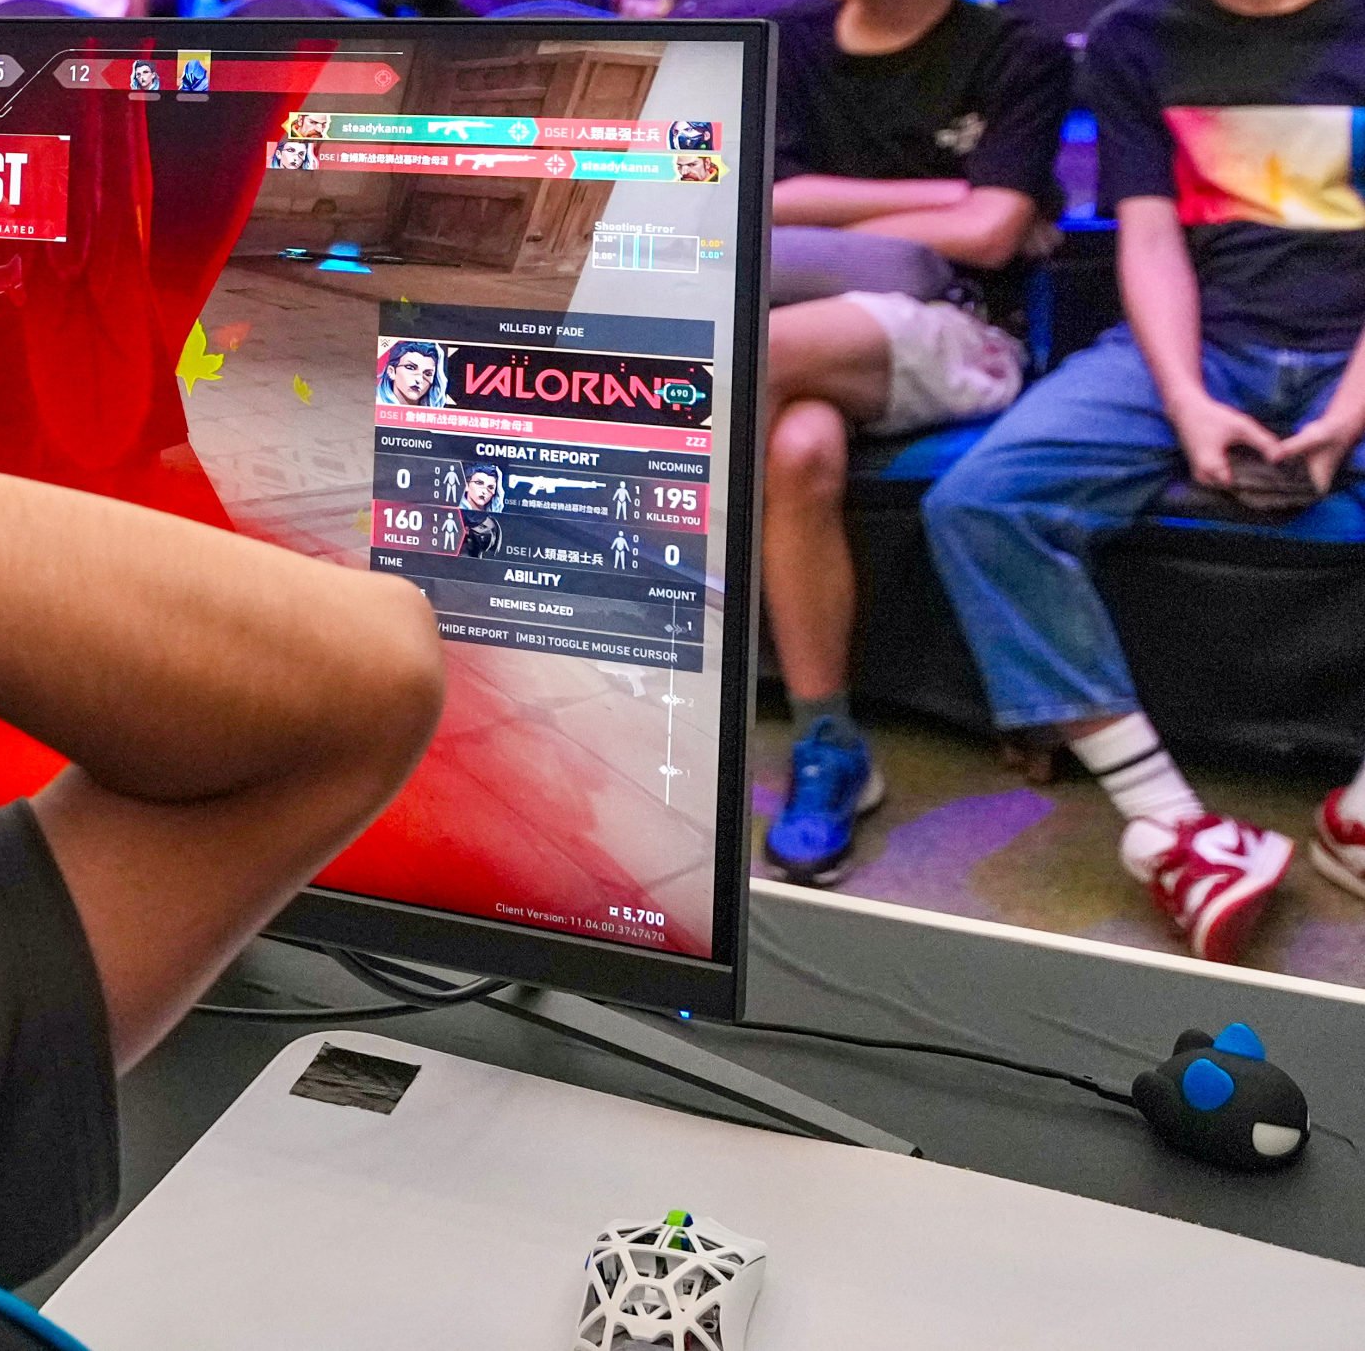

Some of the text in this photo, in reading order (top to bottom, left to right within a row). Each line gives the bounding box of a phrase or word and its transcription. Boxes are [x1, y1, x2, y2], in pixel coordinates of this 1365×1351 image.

[69, 65, 90, 82] 12
[342, 122, 413, 135] steadykanna
[581, 160, 659, 175] steadykanna
[594, 221, 676, 234] Shooting Error
[499, 322, 584, 338] KILLED BY FADE
[670, 388, 689, 398] 690
[381, 436, 432, 450] OUTGOING
[476, 443, 600, 467] COMBAT REPORT
[648, 460, 703, 475] INCOMING
[397, 468, 411, 489] 0
[654, 486, 697, 510] 195
[383, 508, 423, 531] 160
[646, 512, 701, 526] KILLED YOU
[384, 533, 420, 546] KILLED
[378, 555, 403, 568] TIME
[664, 544, 680, 566] 0
[504, 568, 562, 587] ABILITY
[648, 586, 697, 602] AMOUNT
[490, 597, 574, 617] ENEMIES DAZED
[468, 626, 509, 640] REPORT
[516, 632, 546, 646] [MB3]
[548, 637, 590, 651] TOGGLE
[592, 642, 631, 656] MOUSE
[633, 647, 678, 663] CURSOR
[495, 902, 524, 916] Client
[526, 908, 568, 924] Version:
